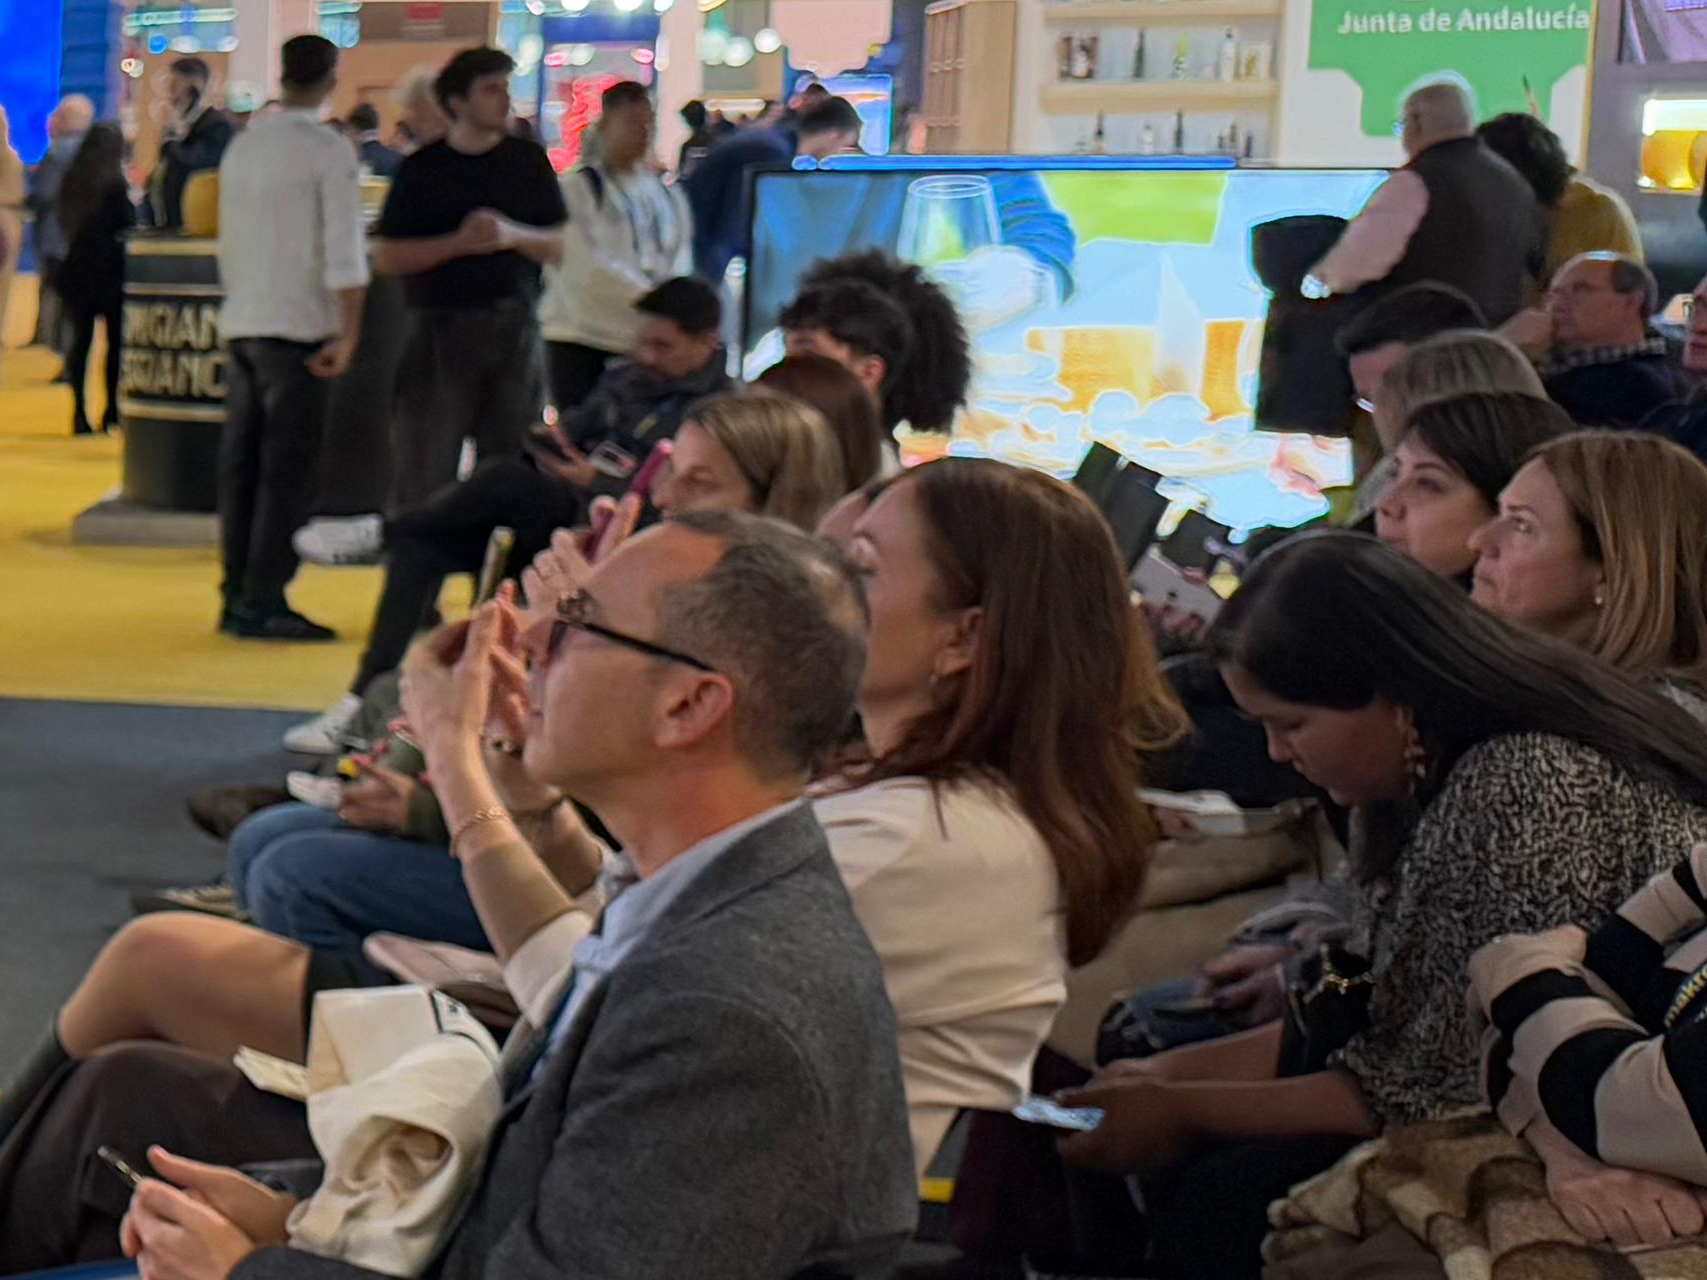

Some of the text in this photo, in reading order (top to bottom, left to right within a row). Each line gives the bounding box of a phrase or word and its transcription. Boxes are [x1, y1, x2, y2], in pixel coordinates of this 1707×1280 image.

[1337, 1, 1591, 34] Junta de Andalucía
